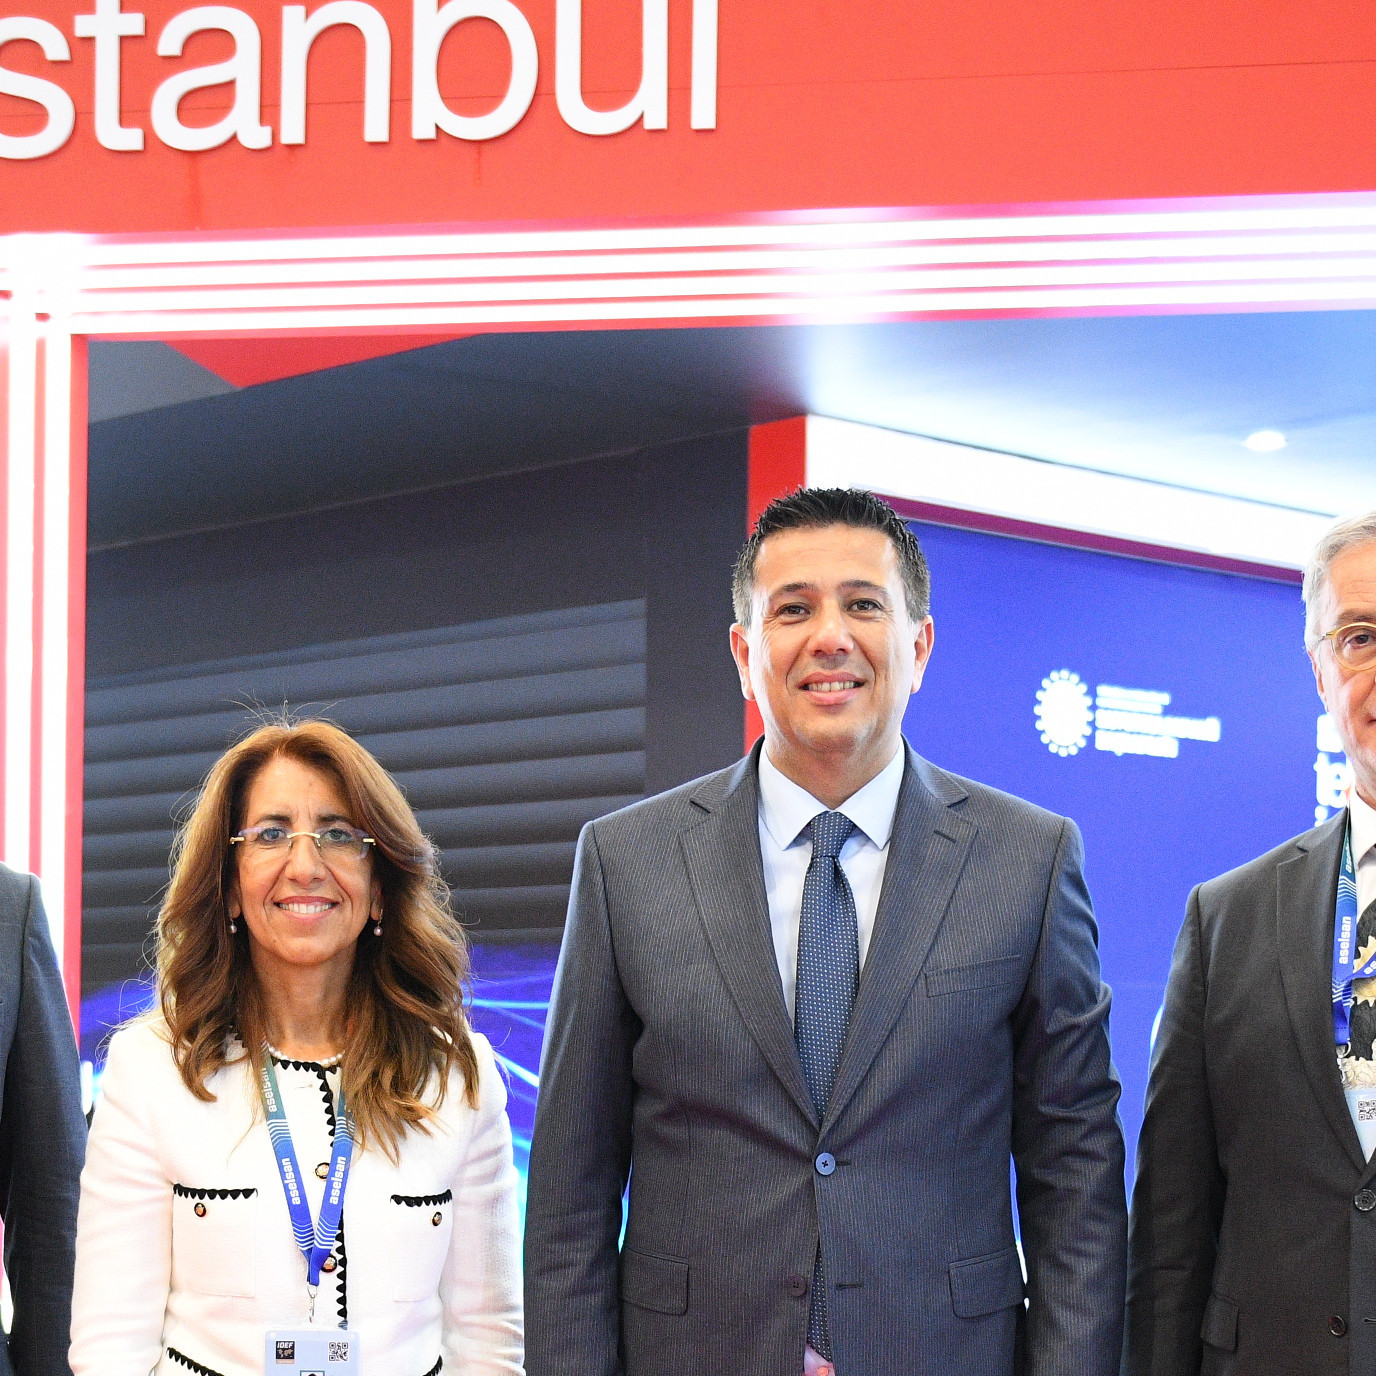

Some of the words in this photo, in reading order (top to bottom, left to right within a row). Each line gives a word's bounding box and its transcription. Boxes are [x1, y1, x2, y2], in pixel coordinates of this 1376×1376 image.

[1338, 916, 1352, 965] aselsan
[282, 1157, 301, 1205] aselsan
[329, 1156, 347, 1205] aselsan
[277, 1341, 294, 1349] IDEF
